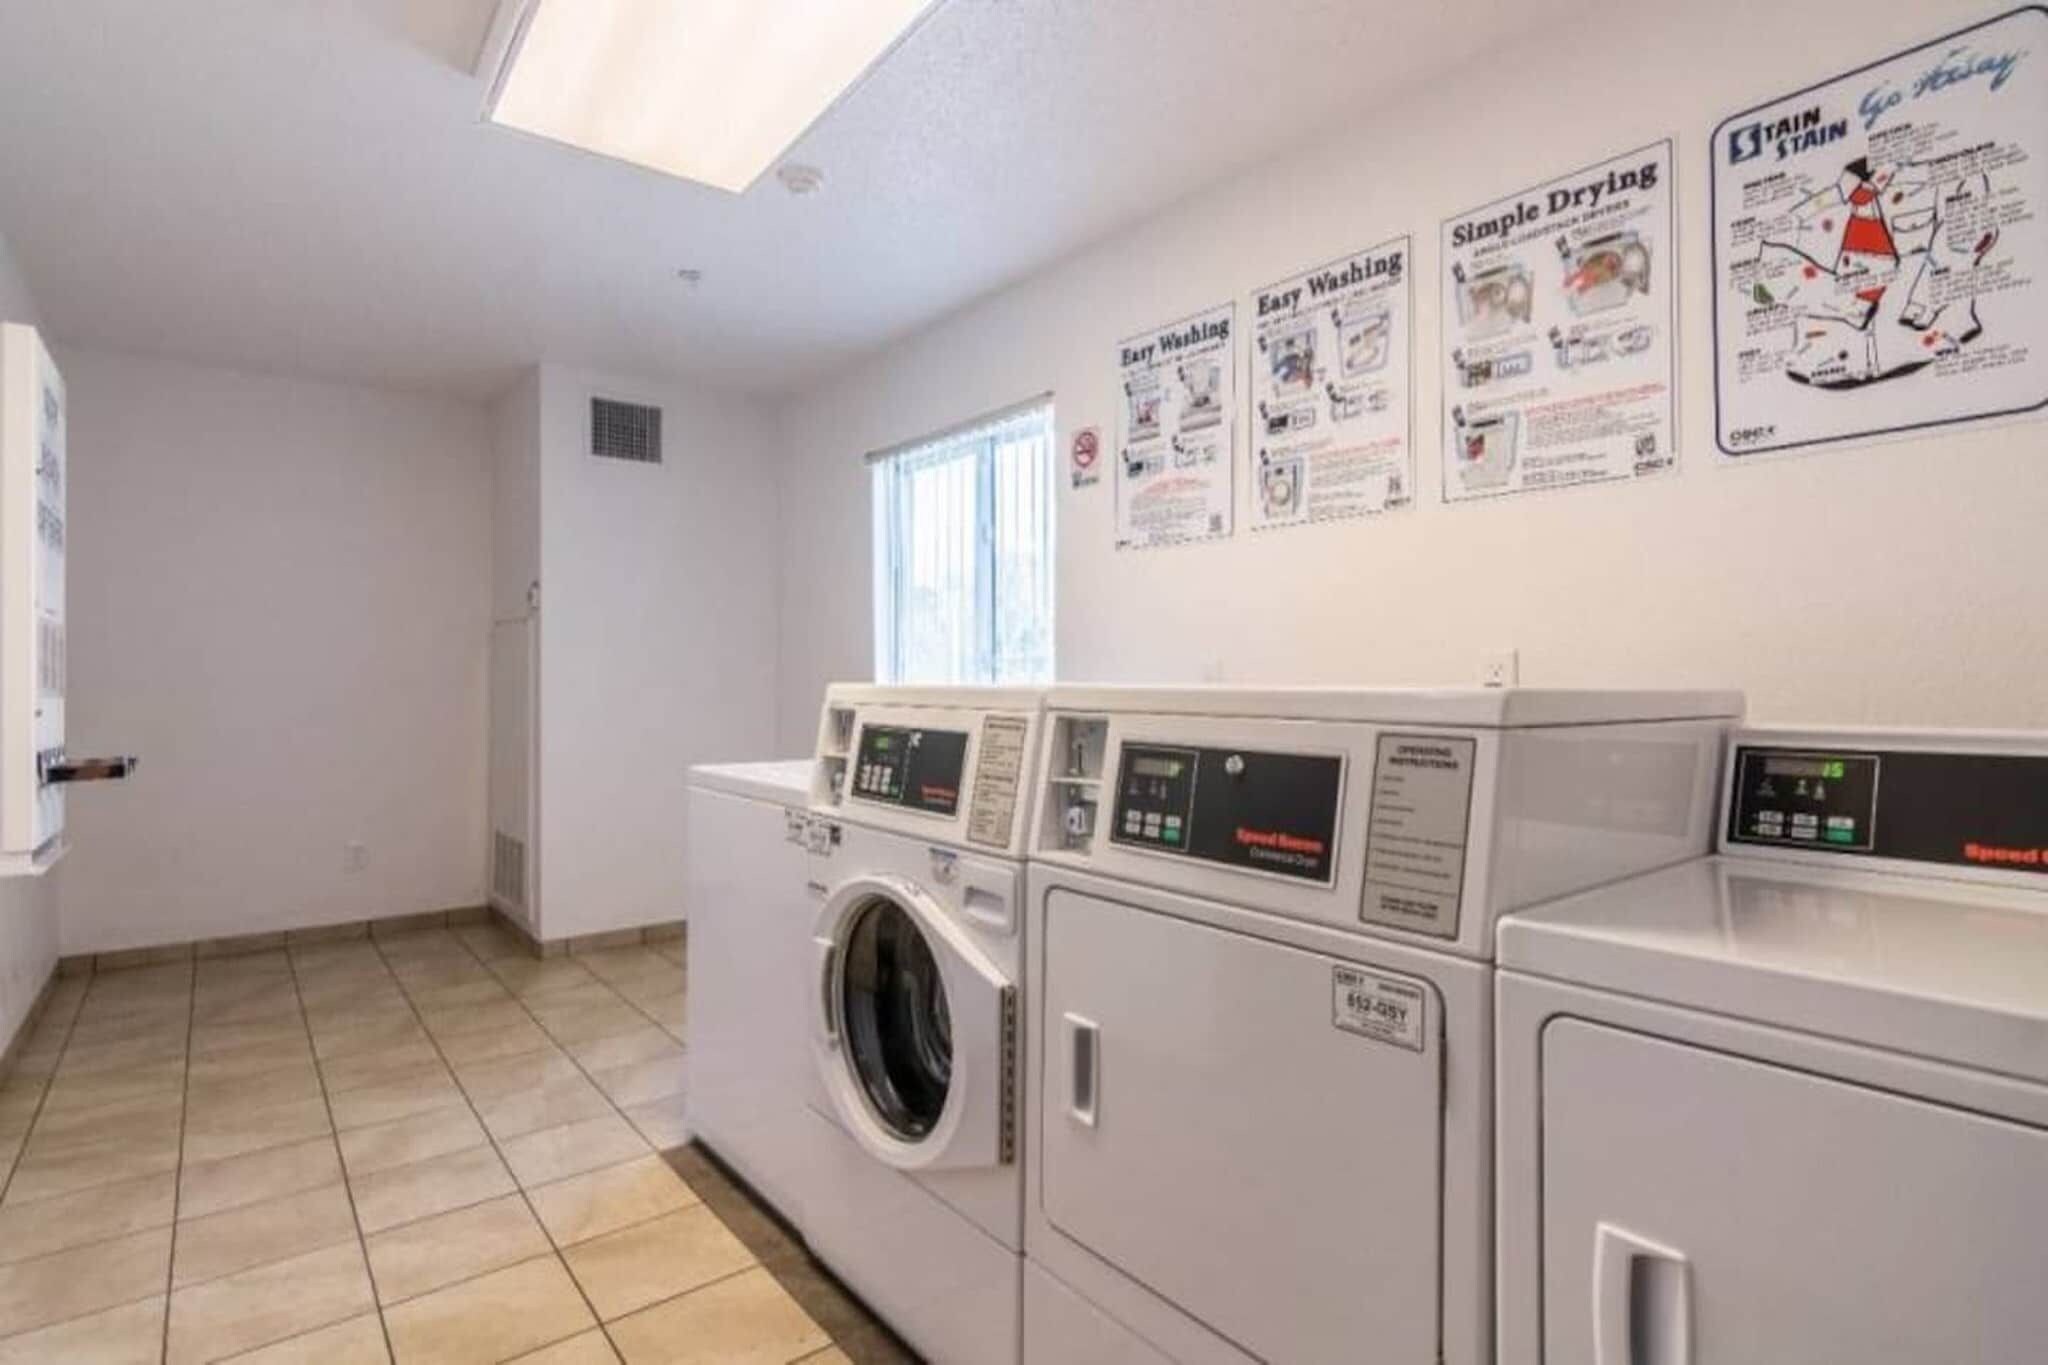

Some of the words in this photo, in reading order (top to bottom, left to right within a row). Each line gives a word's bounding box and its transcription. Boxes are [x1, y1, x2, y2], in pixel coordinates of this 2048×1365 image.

[1776, 119, 1847, 160] STAIN
[1451, 201, 1540, 248] Simple
[1546, 161, 1659, 216] Drying
[1257, 287, 1302, 318] Easy
[1307, 251, 1403, 297] Washing
[1121, 343, 1155, 369] Easy
[1158, 318, 1230, 352] Washing
